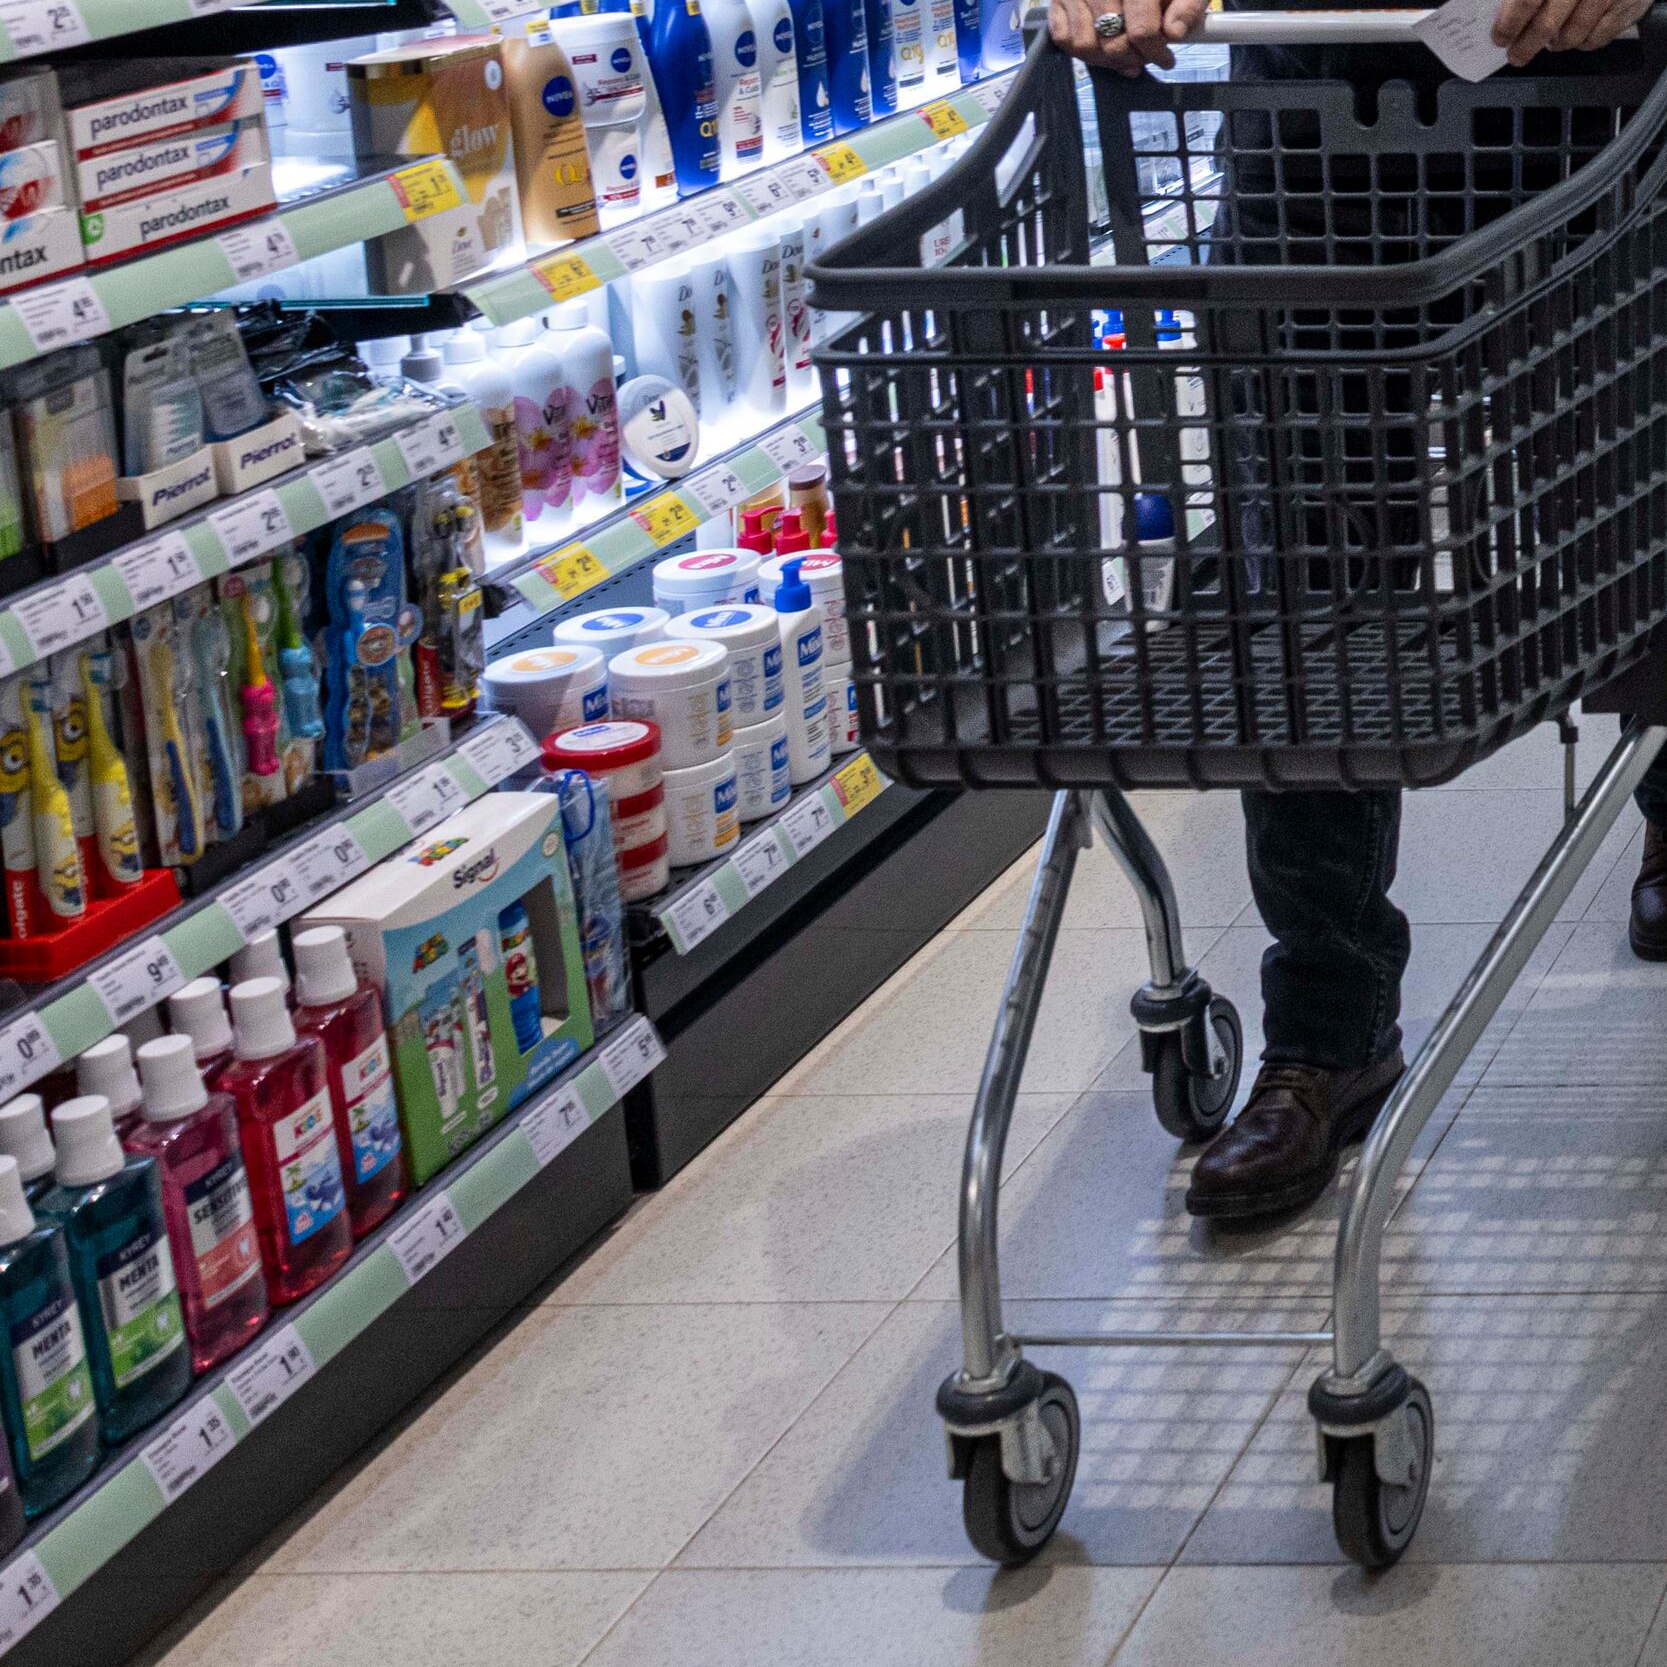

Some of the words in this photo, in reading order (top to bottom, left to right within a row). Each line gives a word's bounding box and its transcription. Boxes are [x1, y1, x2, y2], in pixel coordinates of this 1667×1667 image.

[90, 91, 189, 140] parodontax
[546, 89, 573, 103] NIVEA
[96, 144, 189, 188] parodontax
[140, 194, 229, 241] parodontax
[240, 433, 298, 470] Pierrot
[152, 466, 211, 507] Pierrot
[452, 847, 496, 889] Signal
[118, 1254, 160, 1293] MENTA
